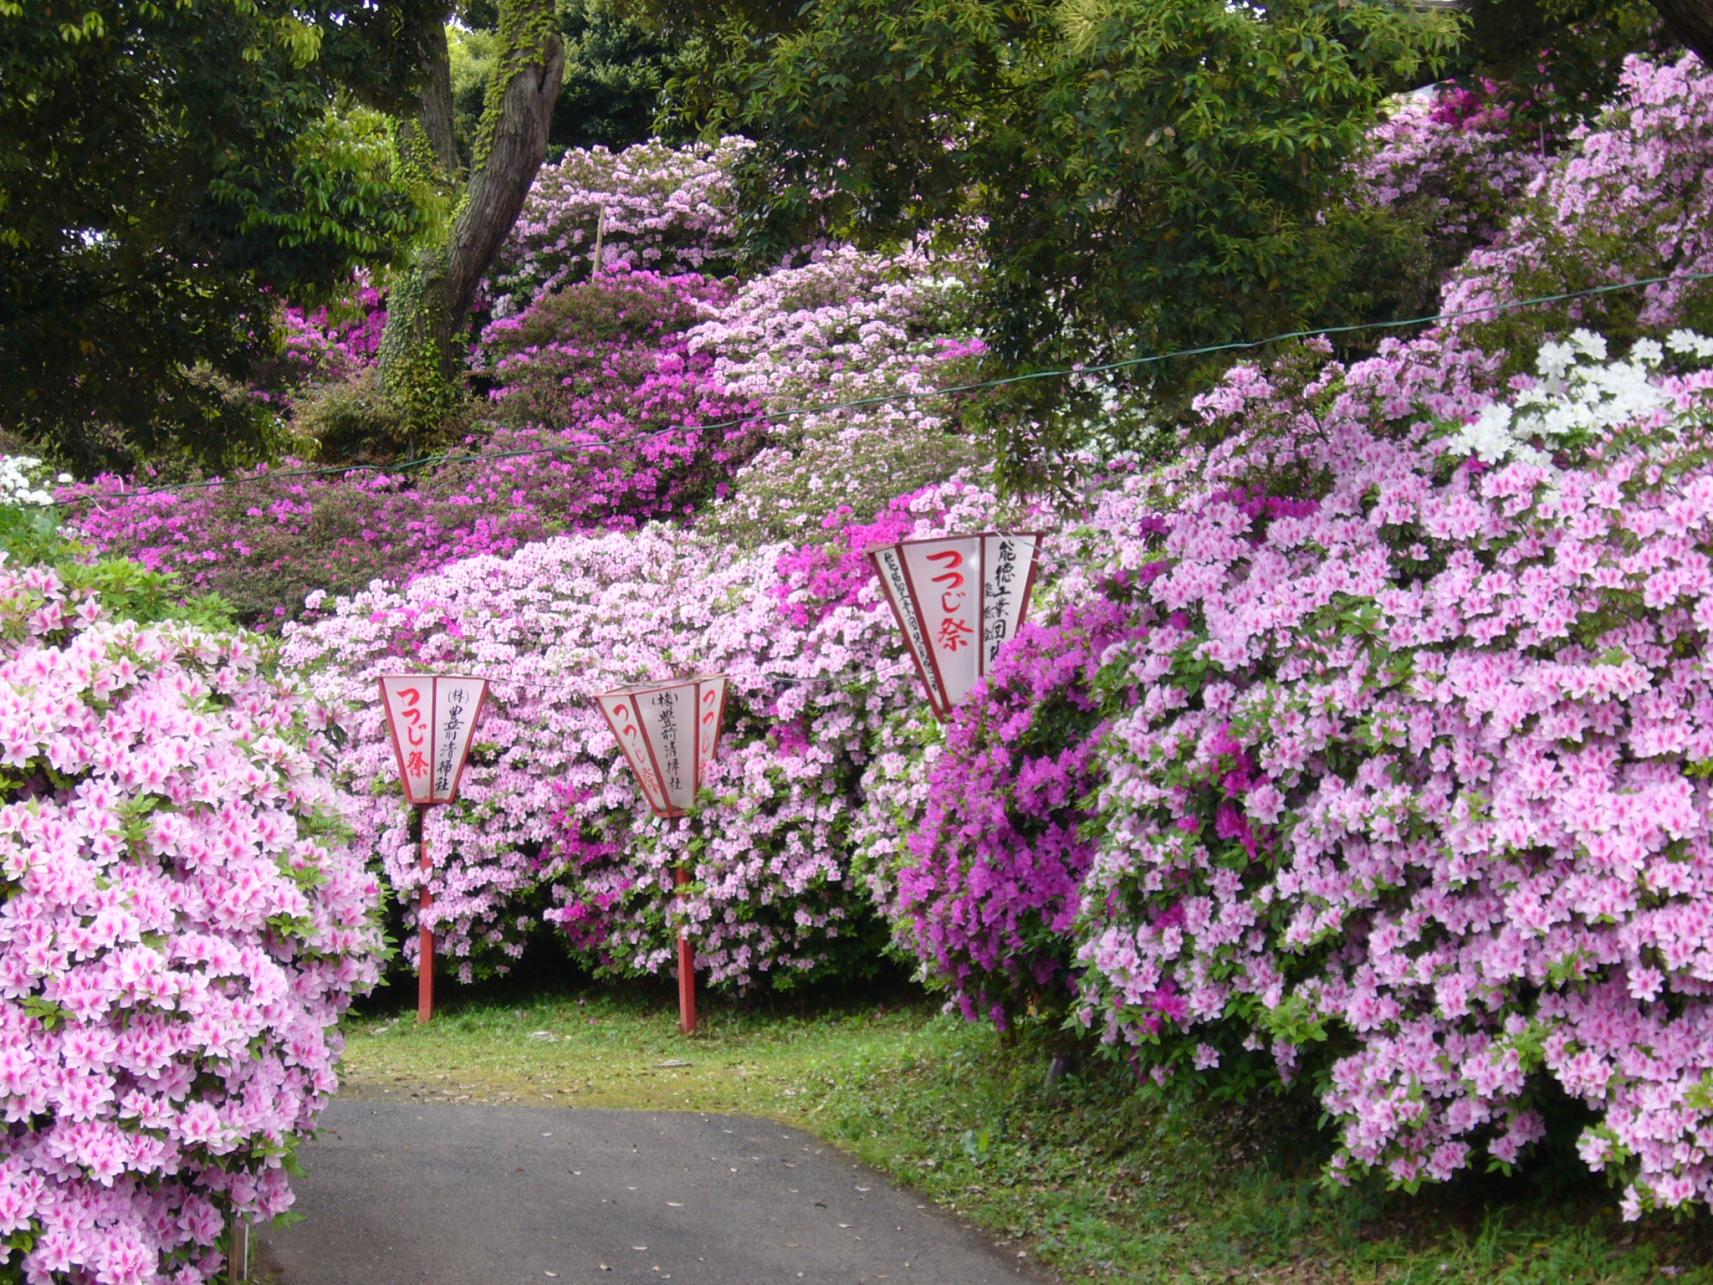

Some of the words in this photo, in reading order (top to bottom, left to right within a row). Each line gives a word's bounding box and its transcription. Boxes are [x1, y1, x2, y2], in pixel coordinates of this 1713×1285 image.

[926, 550, 975, 652] つつじ祭
[396, 687, 429, 779] つつじ祭
[612, 703, 659, 794] つつじ祭
